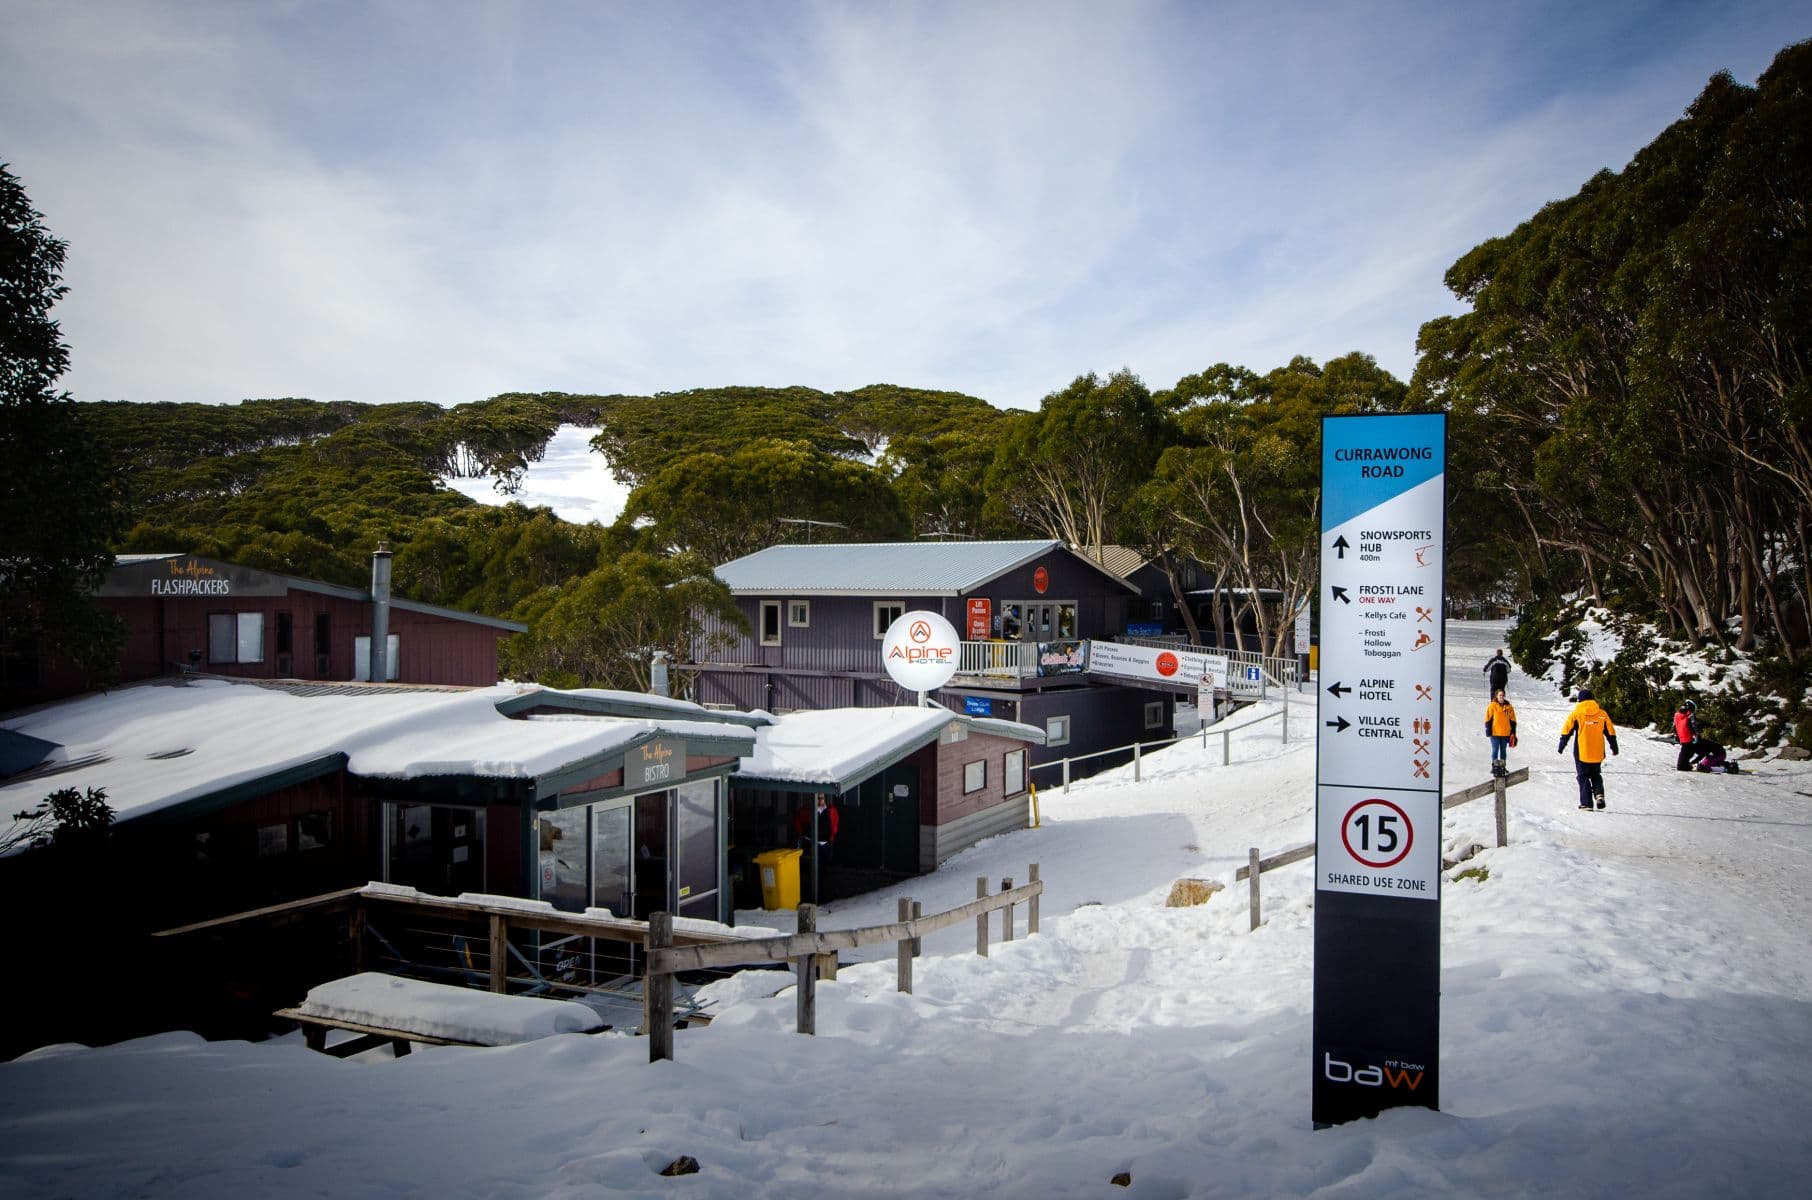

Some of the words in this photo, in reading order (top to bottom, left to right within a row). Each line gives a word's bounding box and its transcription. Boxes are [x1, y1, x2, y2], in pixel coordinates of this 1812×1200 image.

[1335, 447, 1432, 461] CURRAWONG
[1361, 465, 1404, 478] ROAD
[1360, 530, 1432, 540] SNOWSPORTS
[1360, 543, 1382, 552] HUB
[167, 559, 184, 575] The
[186, 559, 215, 580] Alpine
[151, 579, 230, 595] FLASHPACKERS
[1359, 585, 1394, 595] FROSTI
[1397, 586, 1424, 595] LANE
[1359, 596, 1375, 604] ONE
[1378, 596, 1396, 604] WAY
[1364, 611, 1387, 620] Kellys
[1364, 629, 1386, 637] Frosti
[1364, 639, 1392, 647] Hollow
[888, 645, 953, 664] Alpine
[1364, 649, 1402, 659] Toboggan
[1359, 679, 1395, 688] ALPINE
[1359, 691, 1392, 701] HOTEL
[1358, 716, 1400, 726] VILLAGE
[1358, 728, 1404, 739] CENTRAL
[645, 763, 670, 782] BISTRO
[1354, 814, 1398, 852] 15
[1328, 872, 1369, 886] SHARED
[1373, 877, 1393, 888] USE
[1397, 878, 1426, 891] ZONE
[556, 955, 581, 972] OPEN
[1401, 1061, 1424, 1070] baw
[1325, 1052, 1424, 1090] baw
